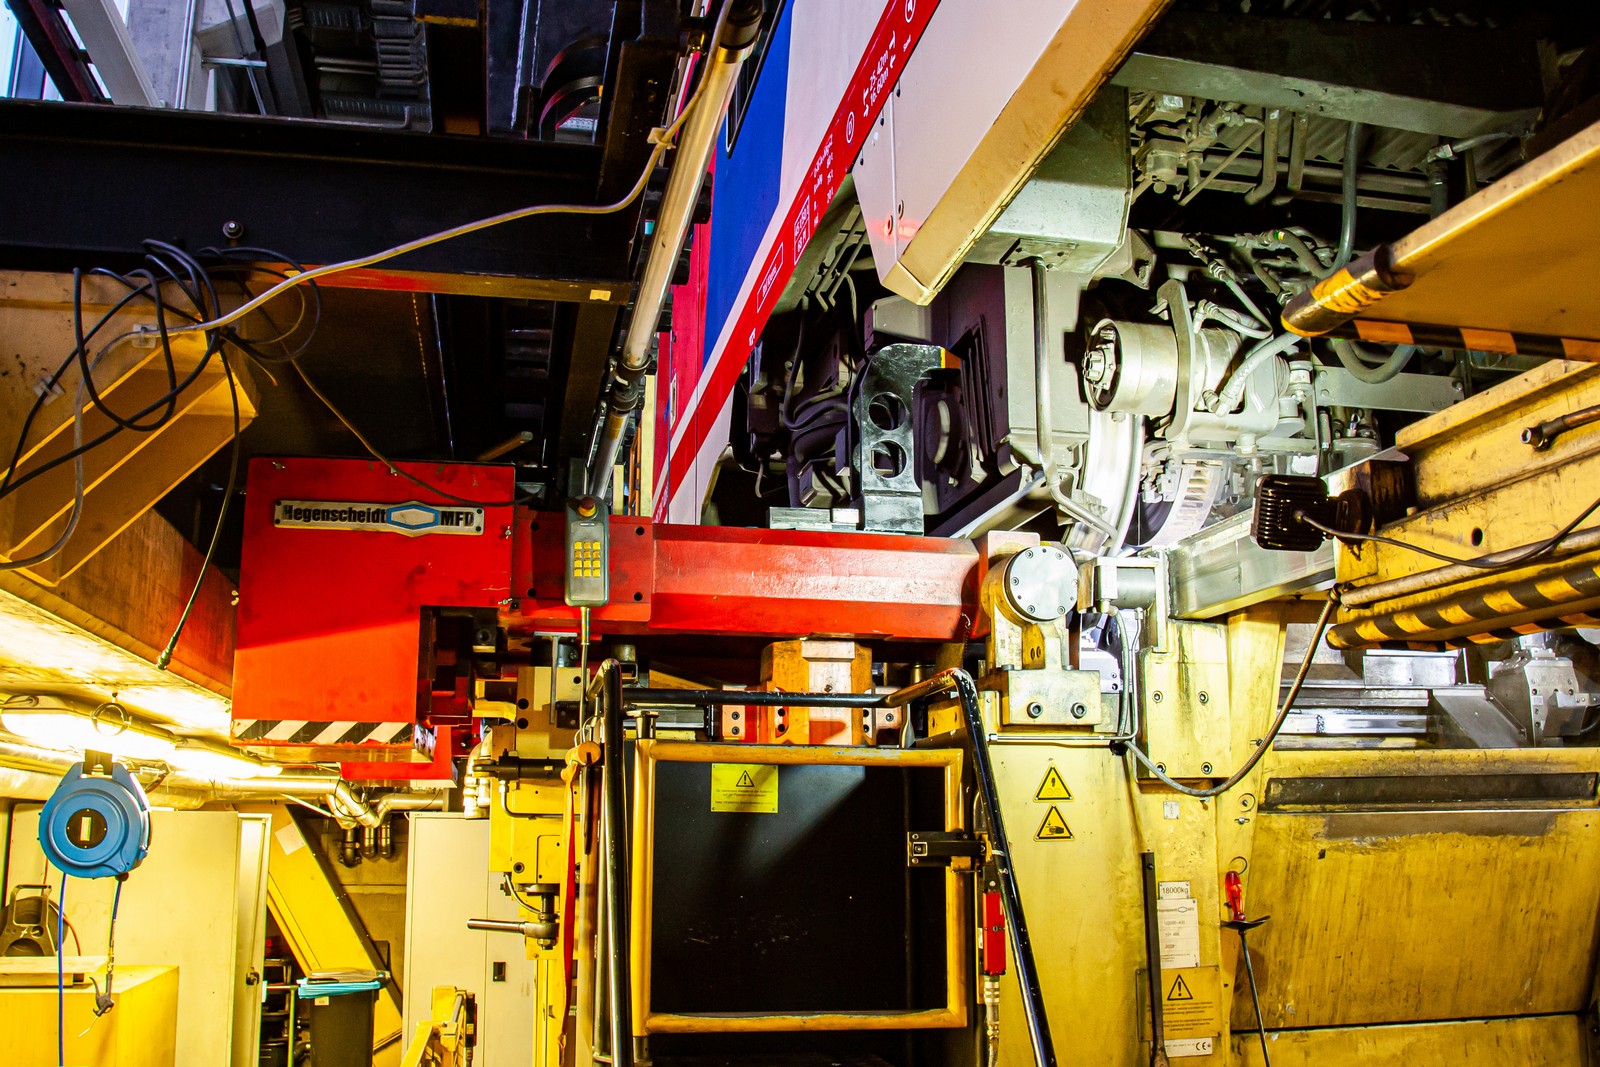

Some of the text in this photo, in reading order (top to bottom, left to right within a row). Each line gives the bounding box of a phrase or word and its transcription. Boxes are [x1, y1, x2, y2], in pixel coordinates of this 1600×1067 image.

[282, 504, 474, 527] Hegenscheidt MFD
[1162, 886, 1189, 895] 18000kg
